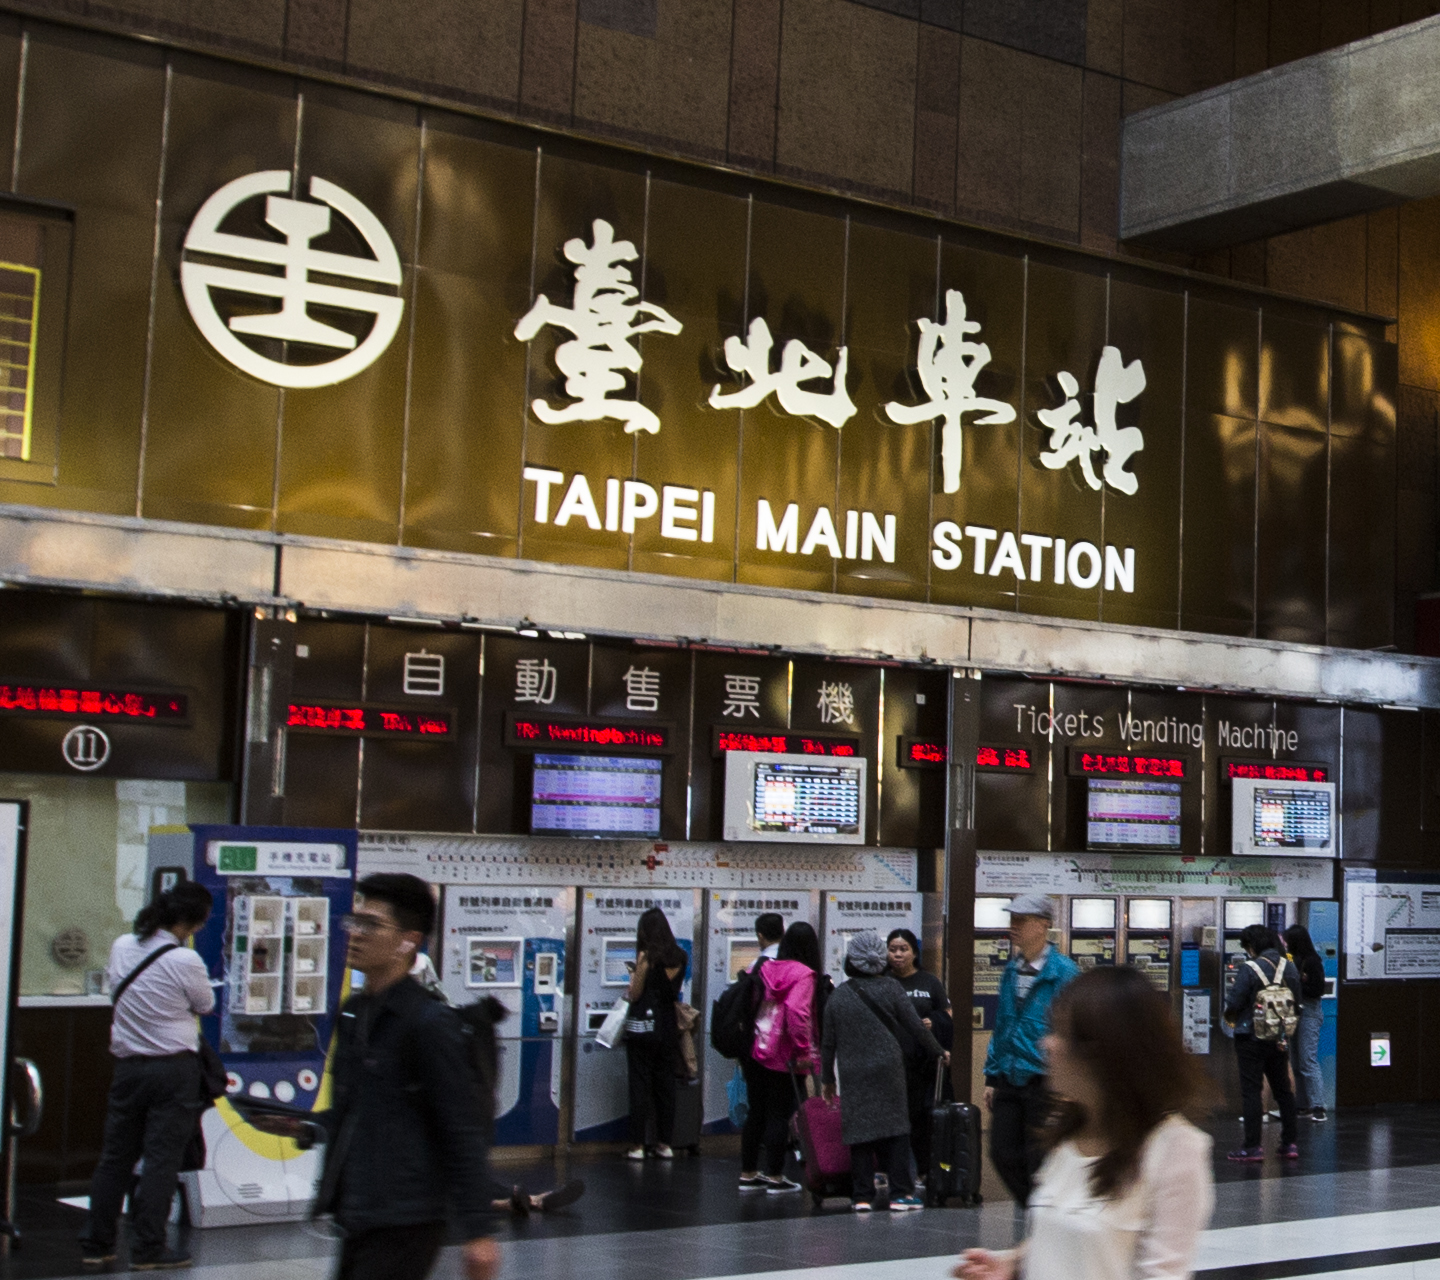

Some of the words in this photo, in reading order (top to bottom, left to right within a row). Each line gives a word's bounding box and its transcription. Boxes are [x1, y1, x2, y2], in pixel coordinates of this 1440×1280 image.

[514, 218, 1147, 497] 臺北車站
[524, 468, 715, 543] TAIPEI
[757, 500, 896, 563] MAIN
[933, 521, 1135, 593] STATION
[403, 649, 856, 726] 自動售票機
[1013, 704, 1104, 738] Tickets
[1118, 713, 1204, 748] Vending
[1219, 721, 1299, 751] Machine
